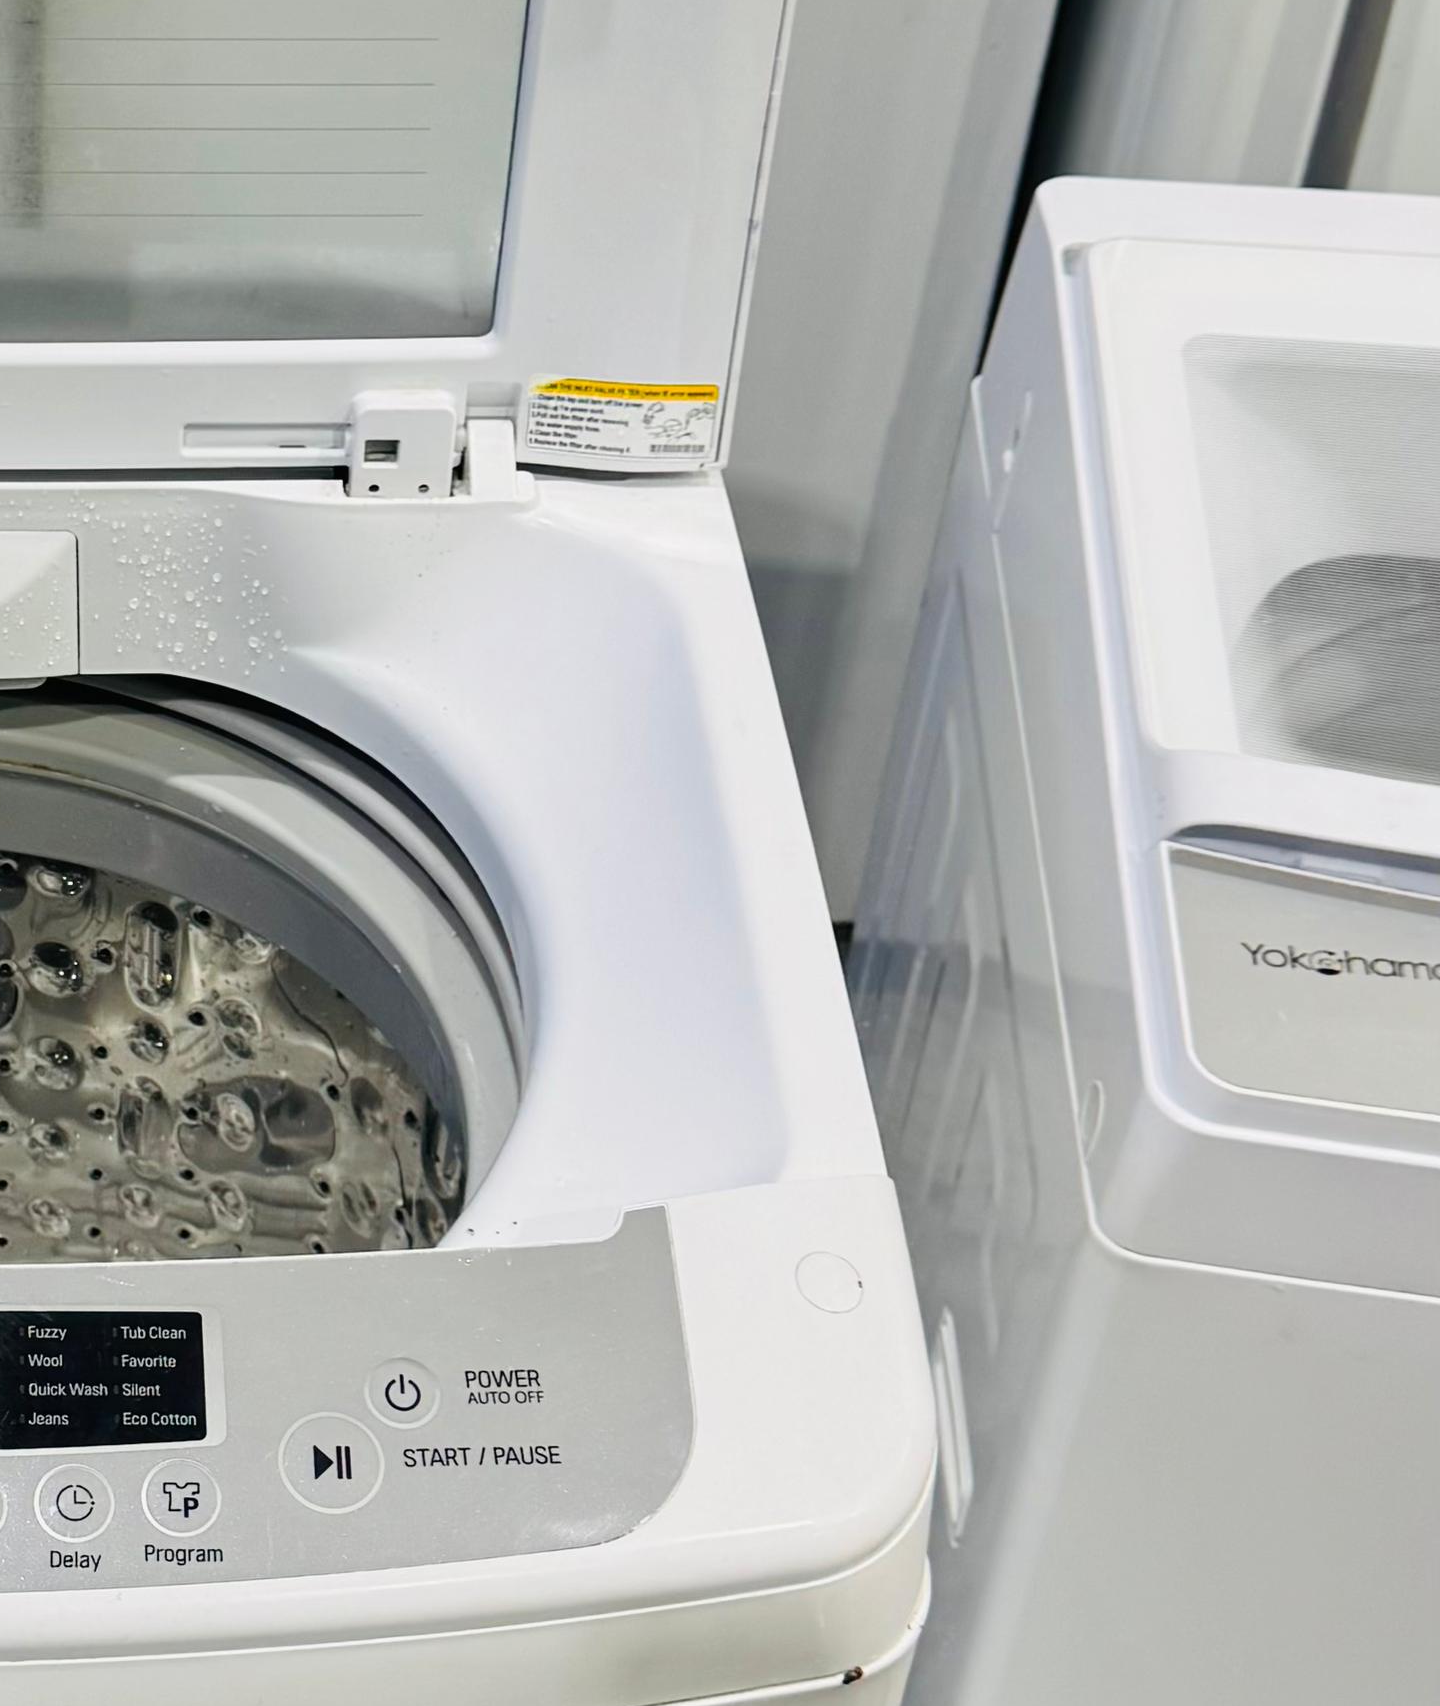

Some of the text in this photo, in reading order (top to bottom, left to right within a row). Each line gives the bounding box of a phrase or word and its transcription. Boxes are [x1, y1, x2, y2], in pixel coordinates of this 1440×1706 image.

[27, 1325, 67, 1342] Fuzzy
[120, 1325, 187, 1340] Tub Clean
[28, 1353, 63, 1368] Wool
[121, 1354, 177, 1369] Favorite
[465, 1370, 541, 1388] POWER
[28, 1382, 108, 1398] Quick Wash
[122, 1382, 161, 1397] Silent
[468, 1390, 545, 1405] AUTO OFF
[28, 1412, 69, 1427] Jeans
[122, 1412, 197, 1427] Eco Cotton
[403, 1445, 562, 1468] START / PAUSE
[49, 1551, 102, 1574] Delay
[144, 1545, 224, 1567] Program
